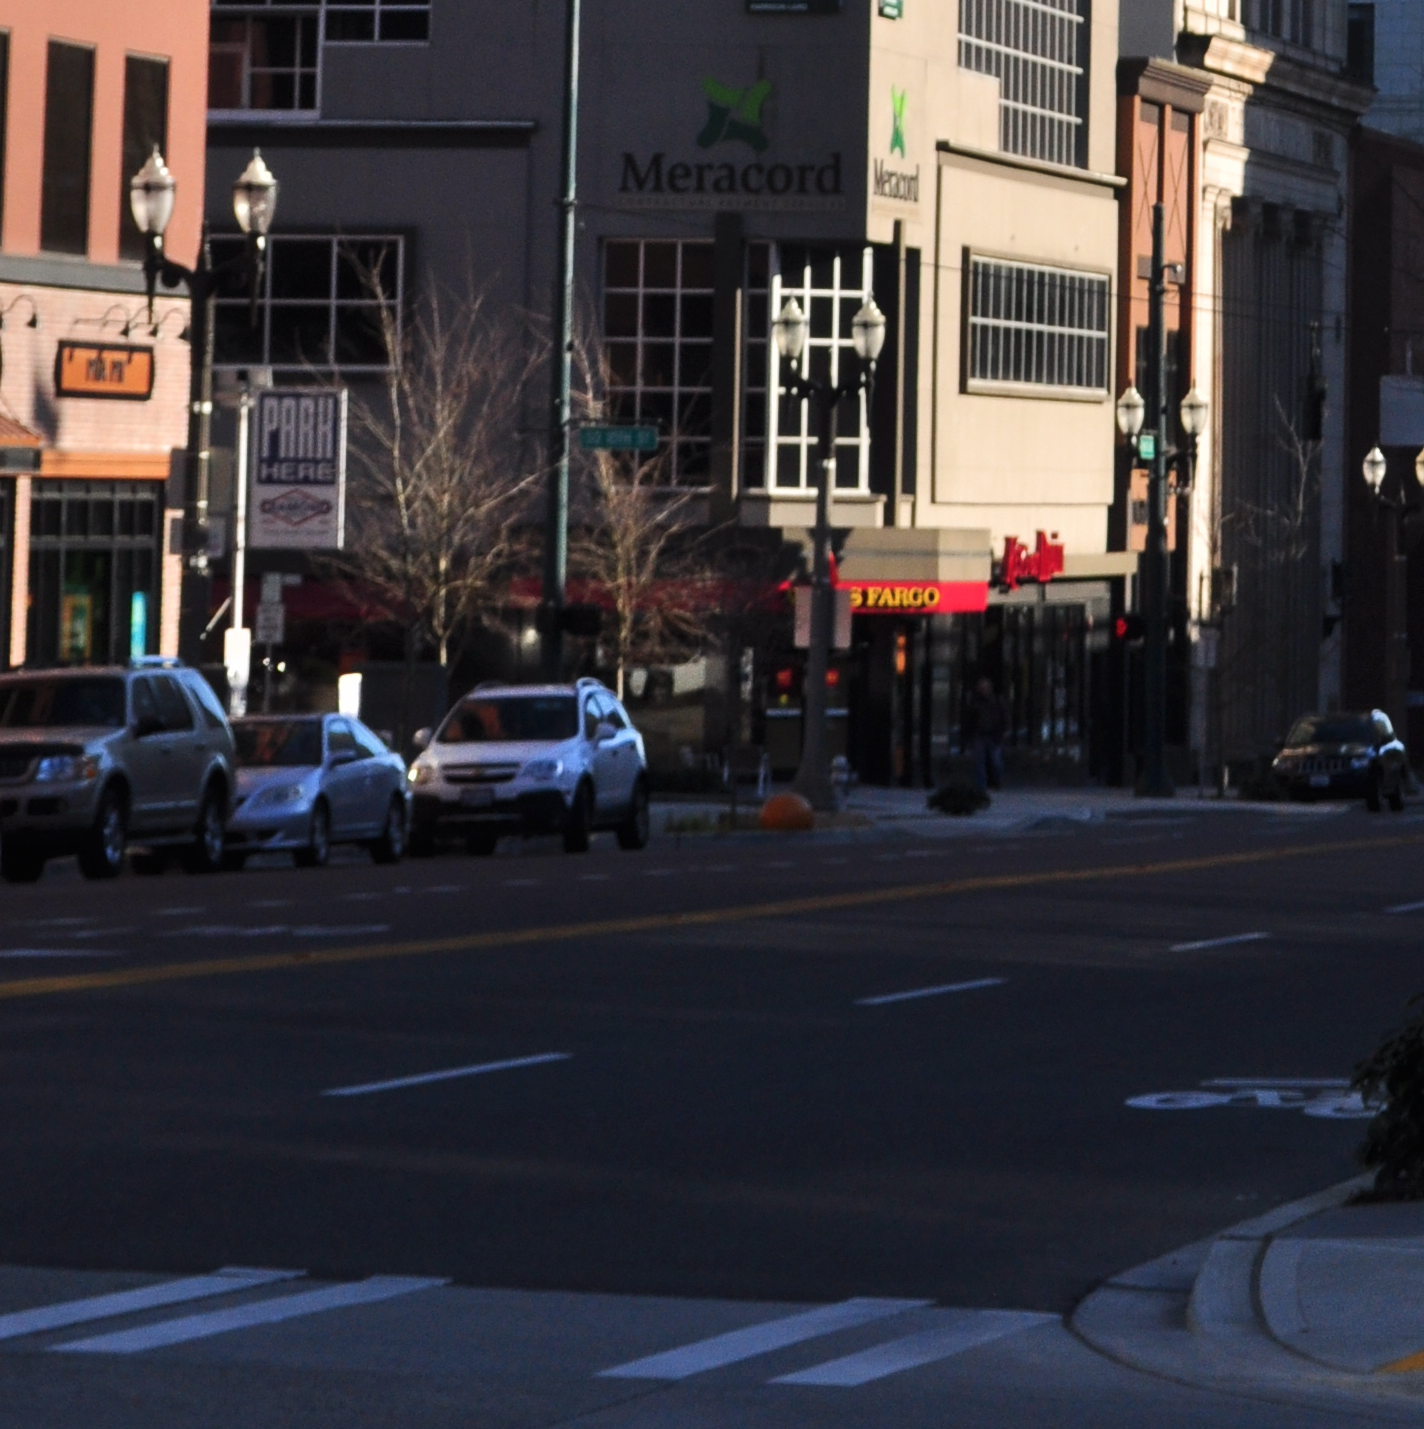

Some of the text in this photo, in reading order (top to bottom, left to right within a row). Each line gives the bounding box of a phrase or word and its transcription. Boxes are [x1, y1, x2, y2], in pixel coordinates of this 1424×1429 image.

[619, 151, 843, 195] Meracord
[873, 157, 920, 203] Meracord
[261, 396, 335, 459] PARK
[260, 462, 334, 481] HERE
[866, 586, 940, 608] FARGO
